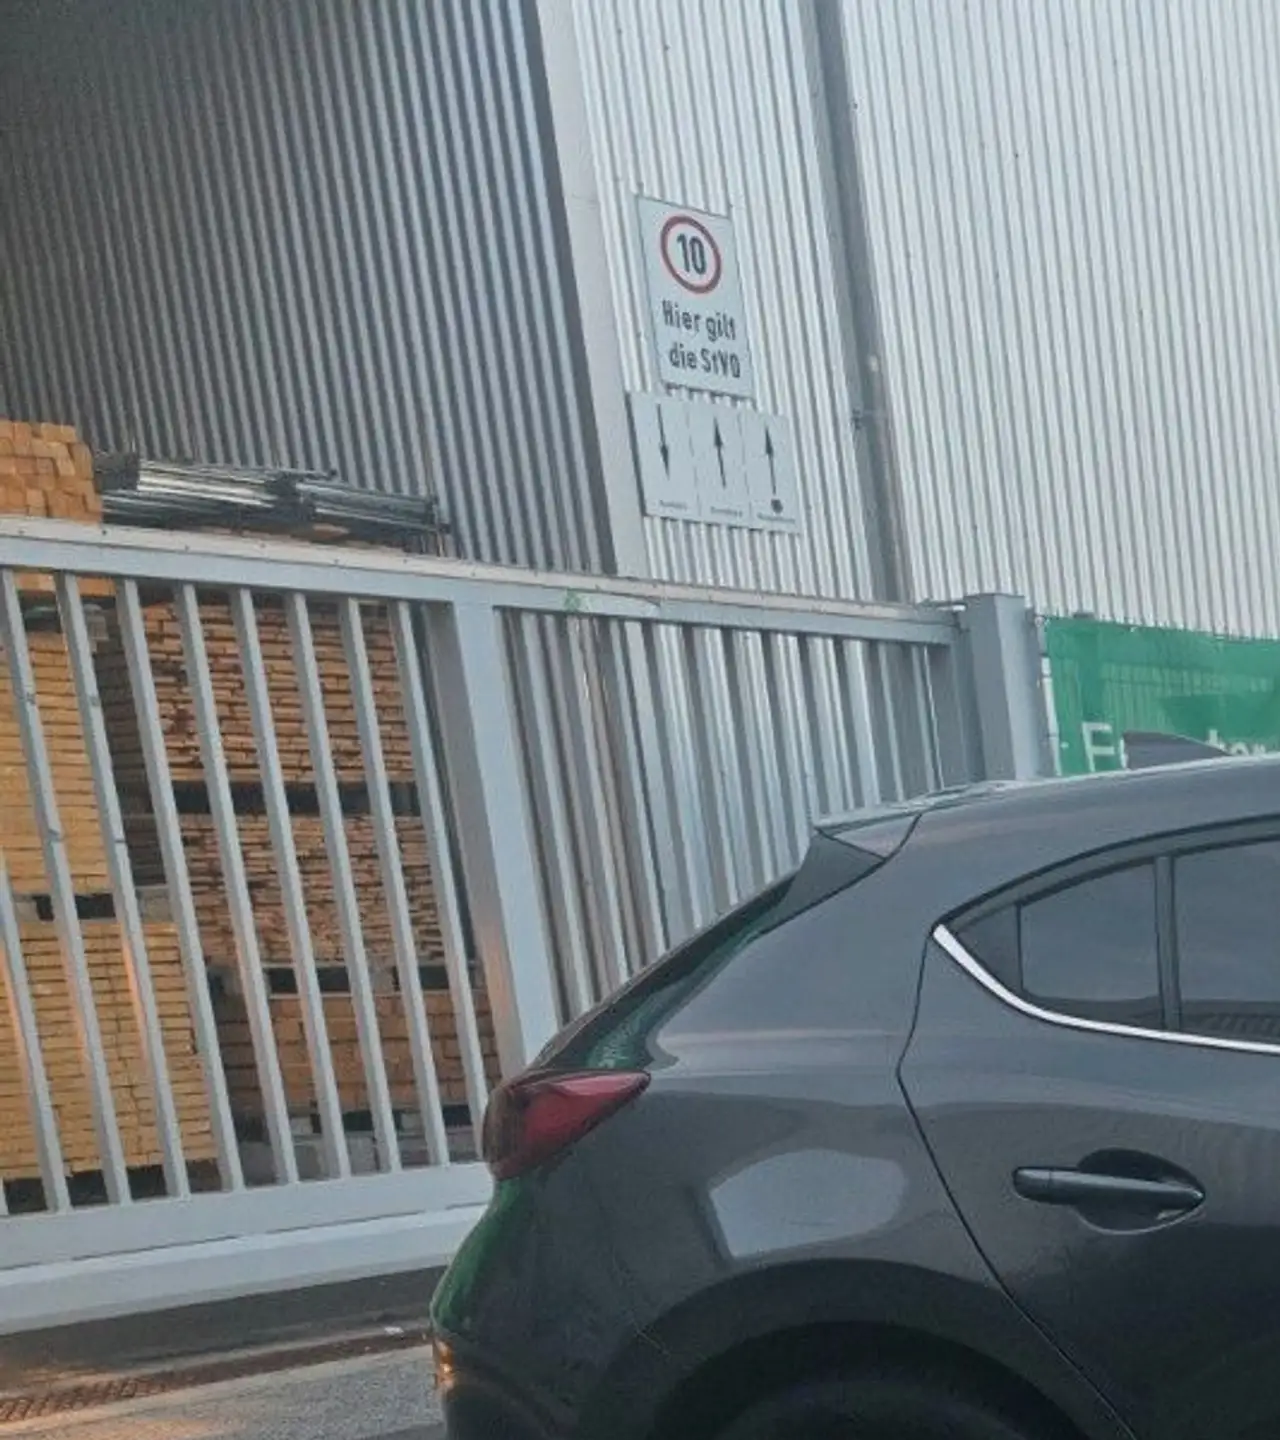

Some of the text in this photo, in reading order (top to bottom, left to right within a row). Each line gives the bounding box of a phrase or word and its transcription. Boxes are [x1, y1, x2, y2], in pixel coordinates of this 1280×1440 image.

[676, 233, 706, 275] 10
[662, 299, 736, 342] Hier gilt
[669, 342, 741, 379] die StVO
